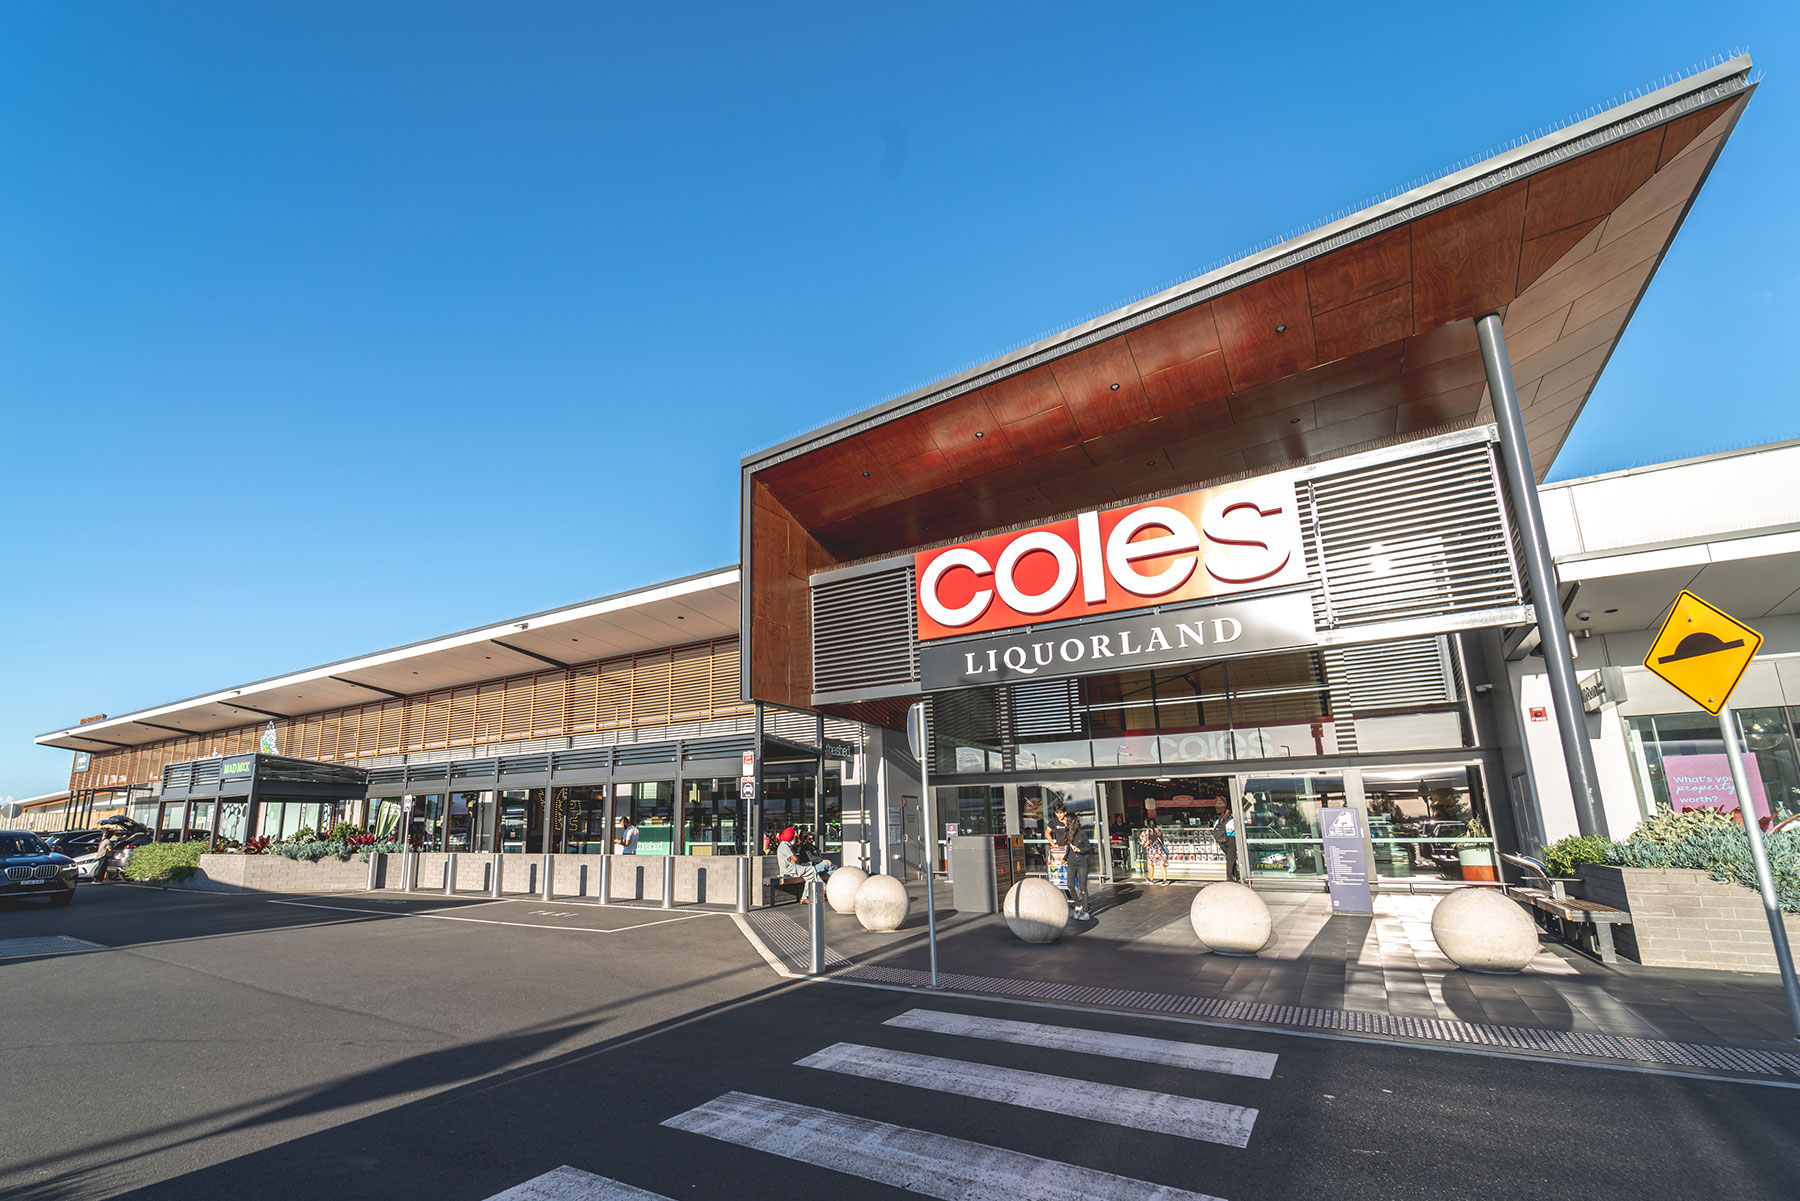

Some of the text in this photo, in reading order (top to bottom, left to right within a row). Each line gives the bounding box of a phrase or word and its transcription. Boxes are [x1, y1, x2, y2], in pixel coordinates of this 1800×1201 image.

[919, 485, 1292, 628] coles
[964, 616, 1243, 675] LIQUORLAND
[223, 760, 251, 775] MAD MEX
[1673, 775, 1712, 783] What's
[1676, 782, 1736, 795] property
[1680, 795, 1718, 803] worth?
